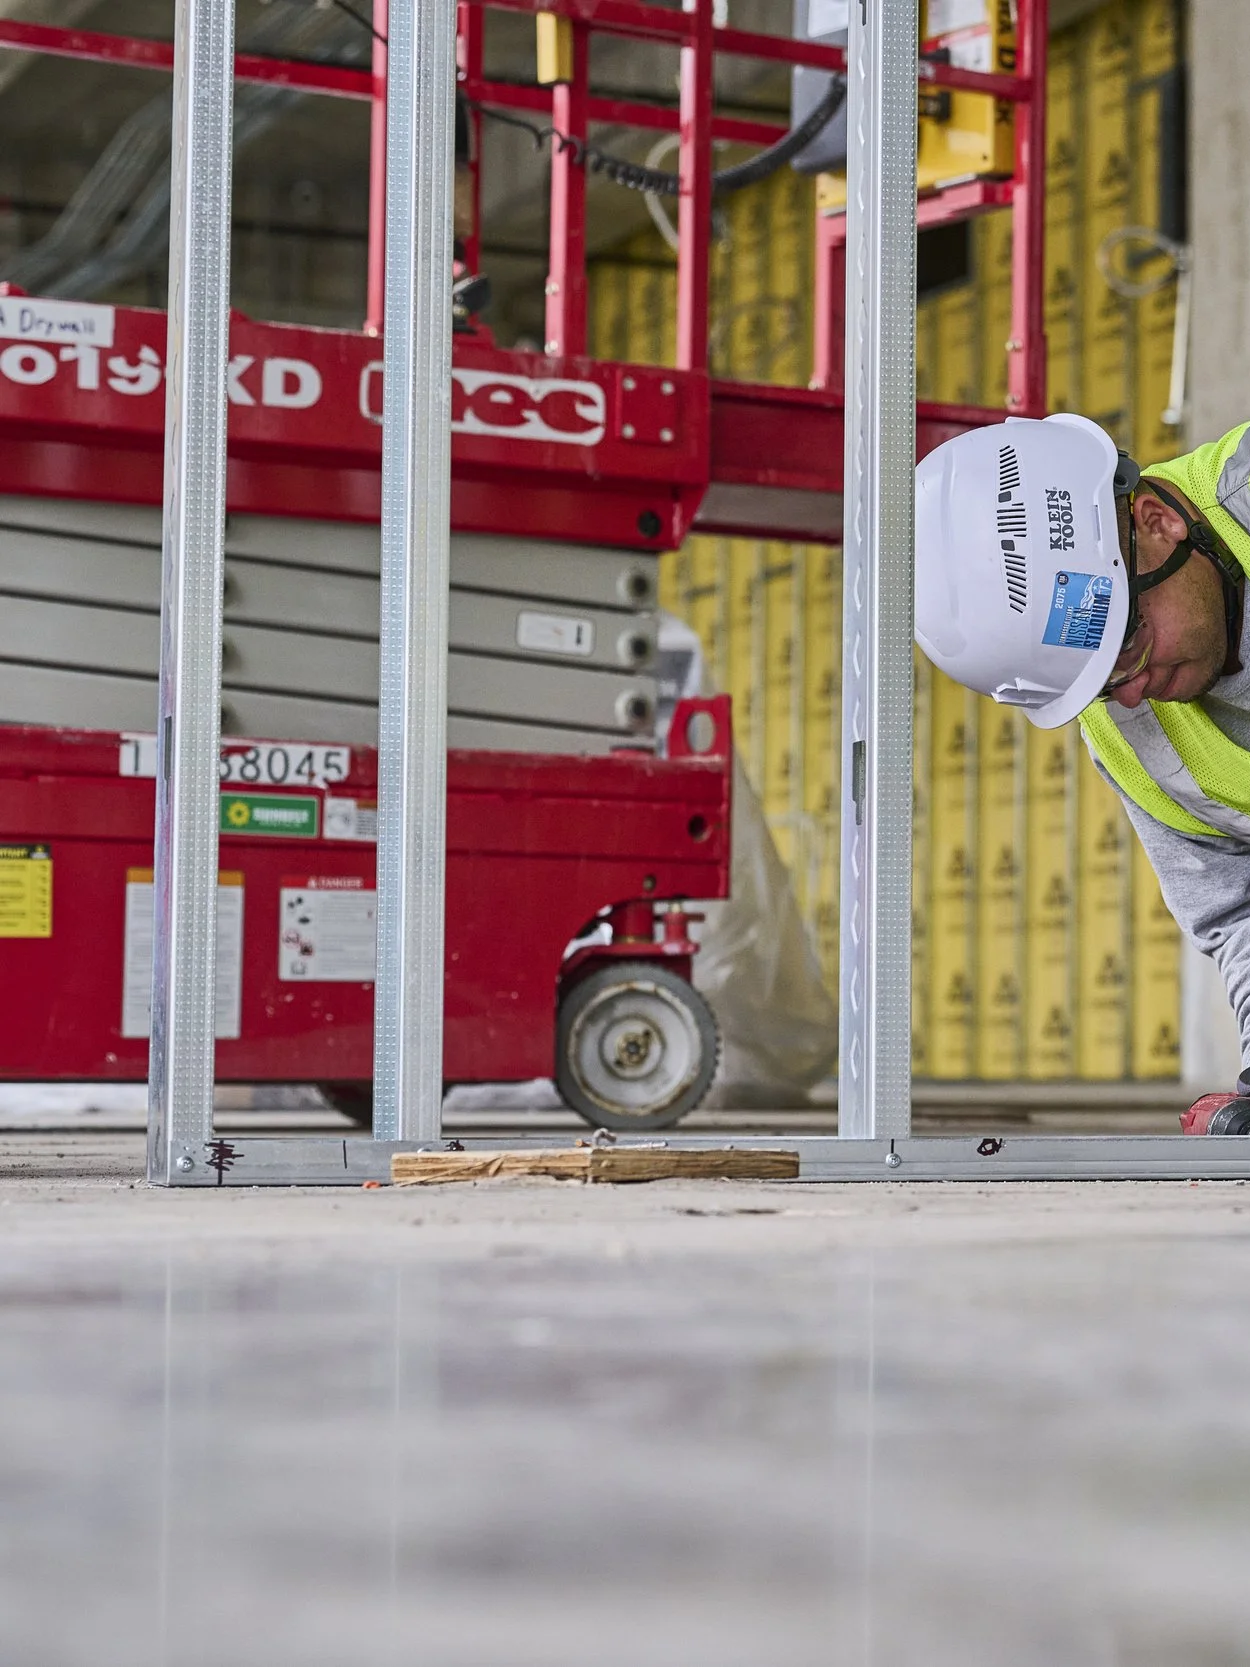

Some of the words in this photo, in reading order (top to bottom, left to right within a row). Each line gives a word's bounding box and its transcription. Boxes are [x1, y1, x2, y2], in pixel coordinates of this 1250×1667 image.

[1045, 489, 1062, 550] KLEIN
[1059, 490, 1074, 551] TOOLS
[1055, 587, 1066, 609] 2075
[1083, 593, 1111, 649] STADIUM
[1065, 607, 1091, 647] NISSAN
